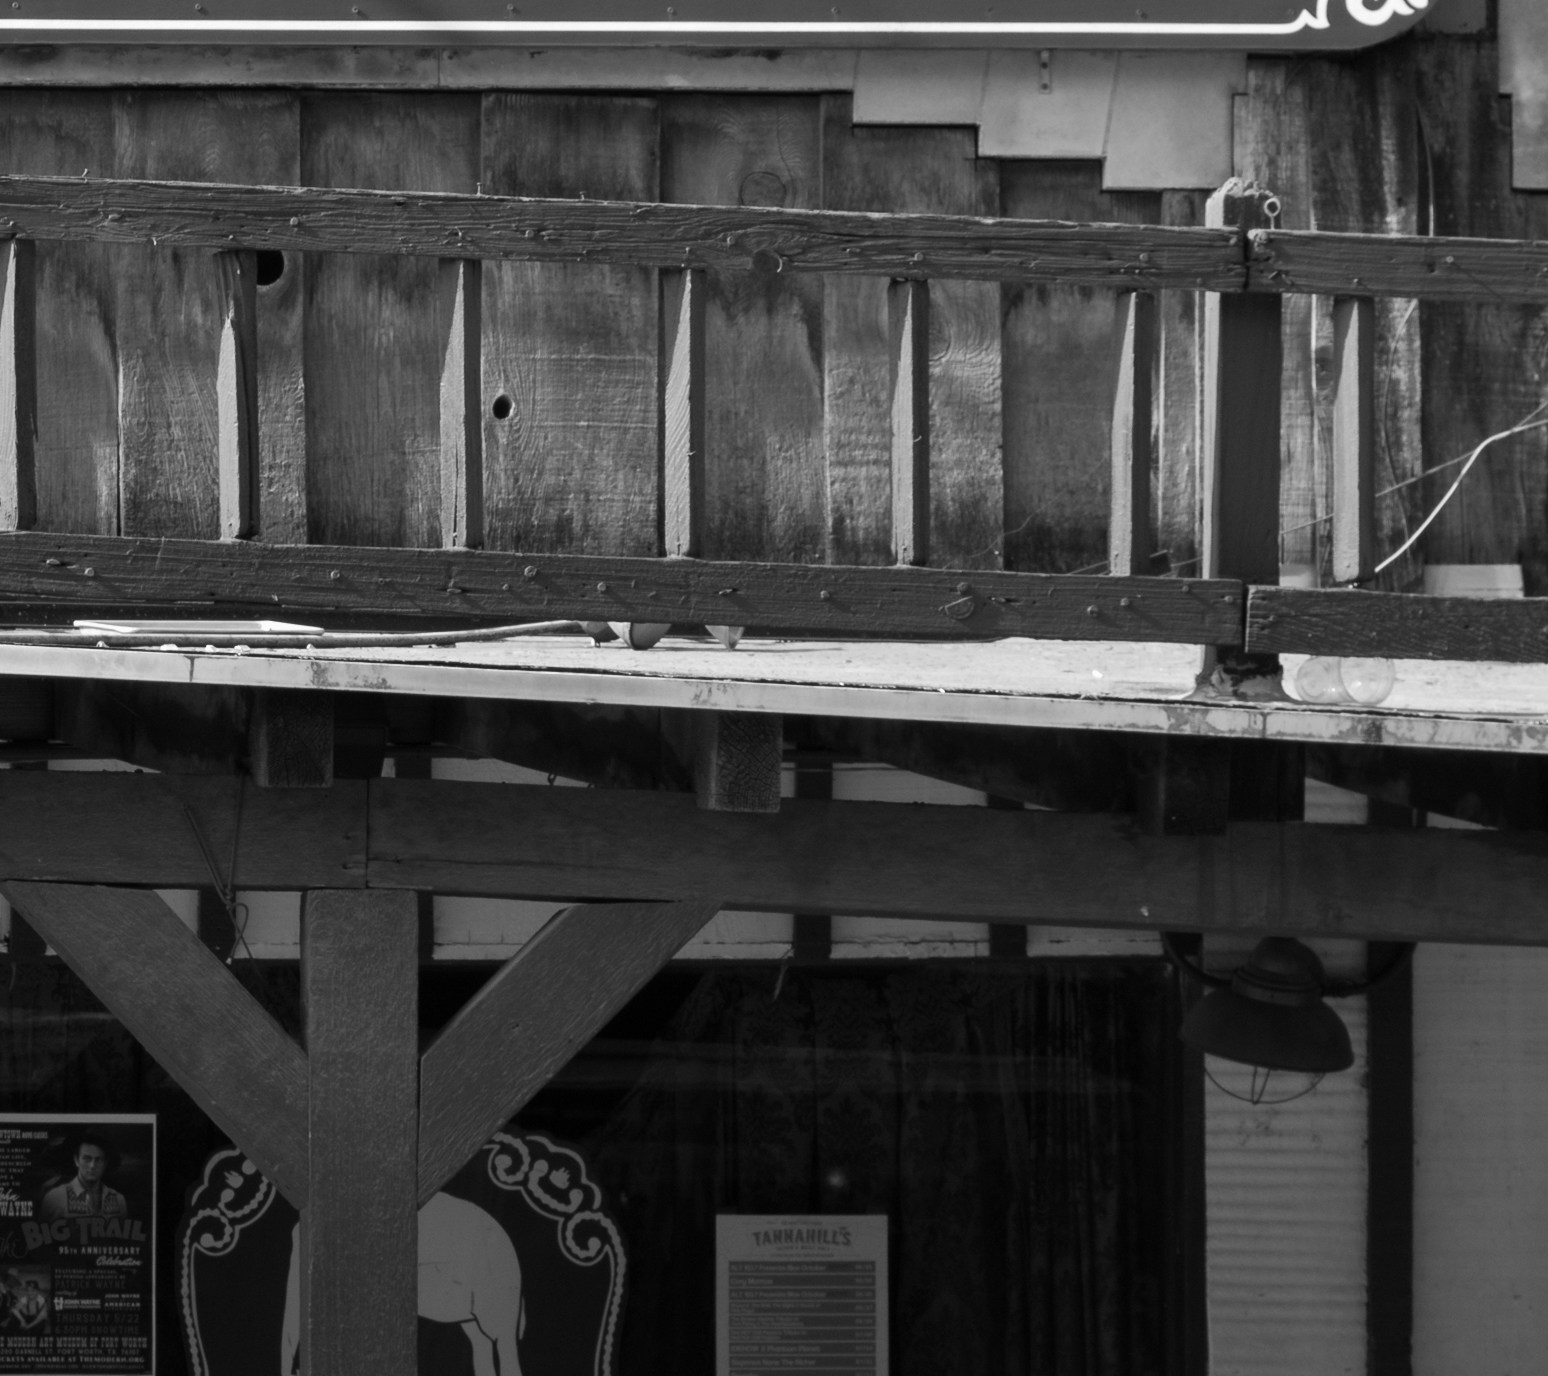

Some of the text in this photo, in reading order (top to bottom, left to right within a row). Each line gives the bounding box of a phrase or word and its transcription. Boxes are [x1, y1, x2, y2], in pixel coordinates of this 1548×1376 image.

[0, 1201, 33, 1216] WAYNE
[21, 1217, 146, 1250] BIG TRAIL
[81, 1246, 140, 1255] ANNIVERSARY
